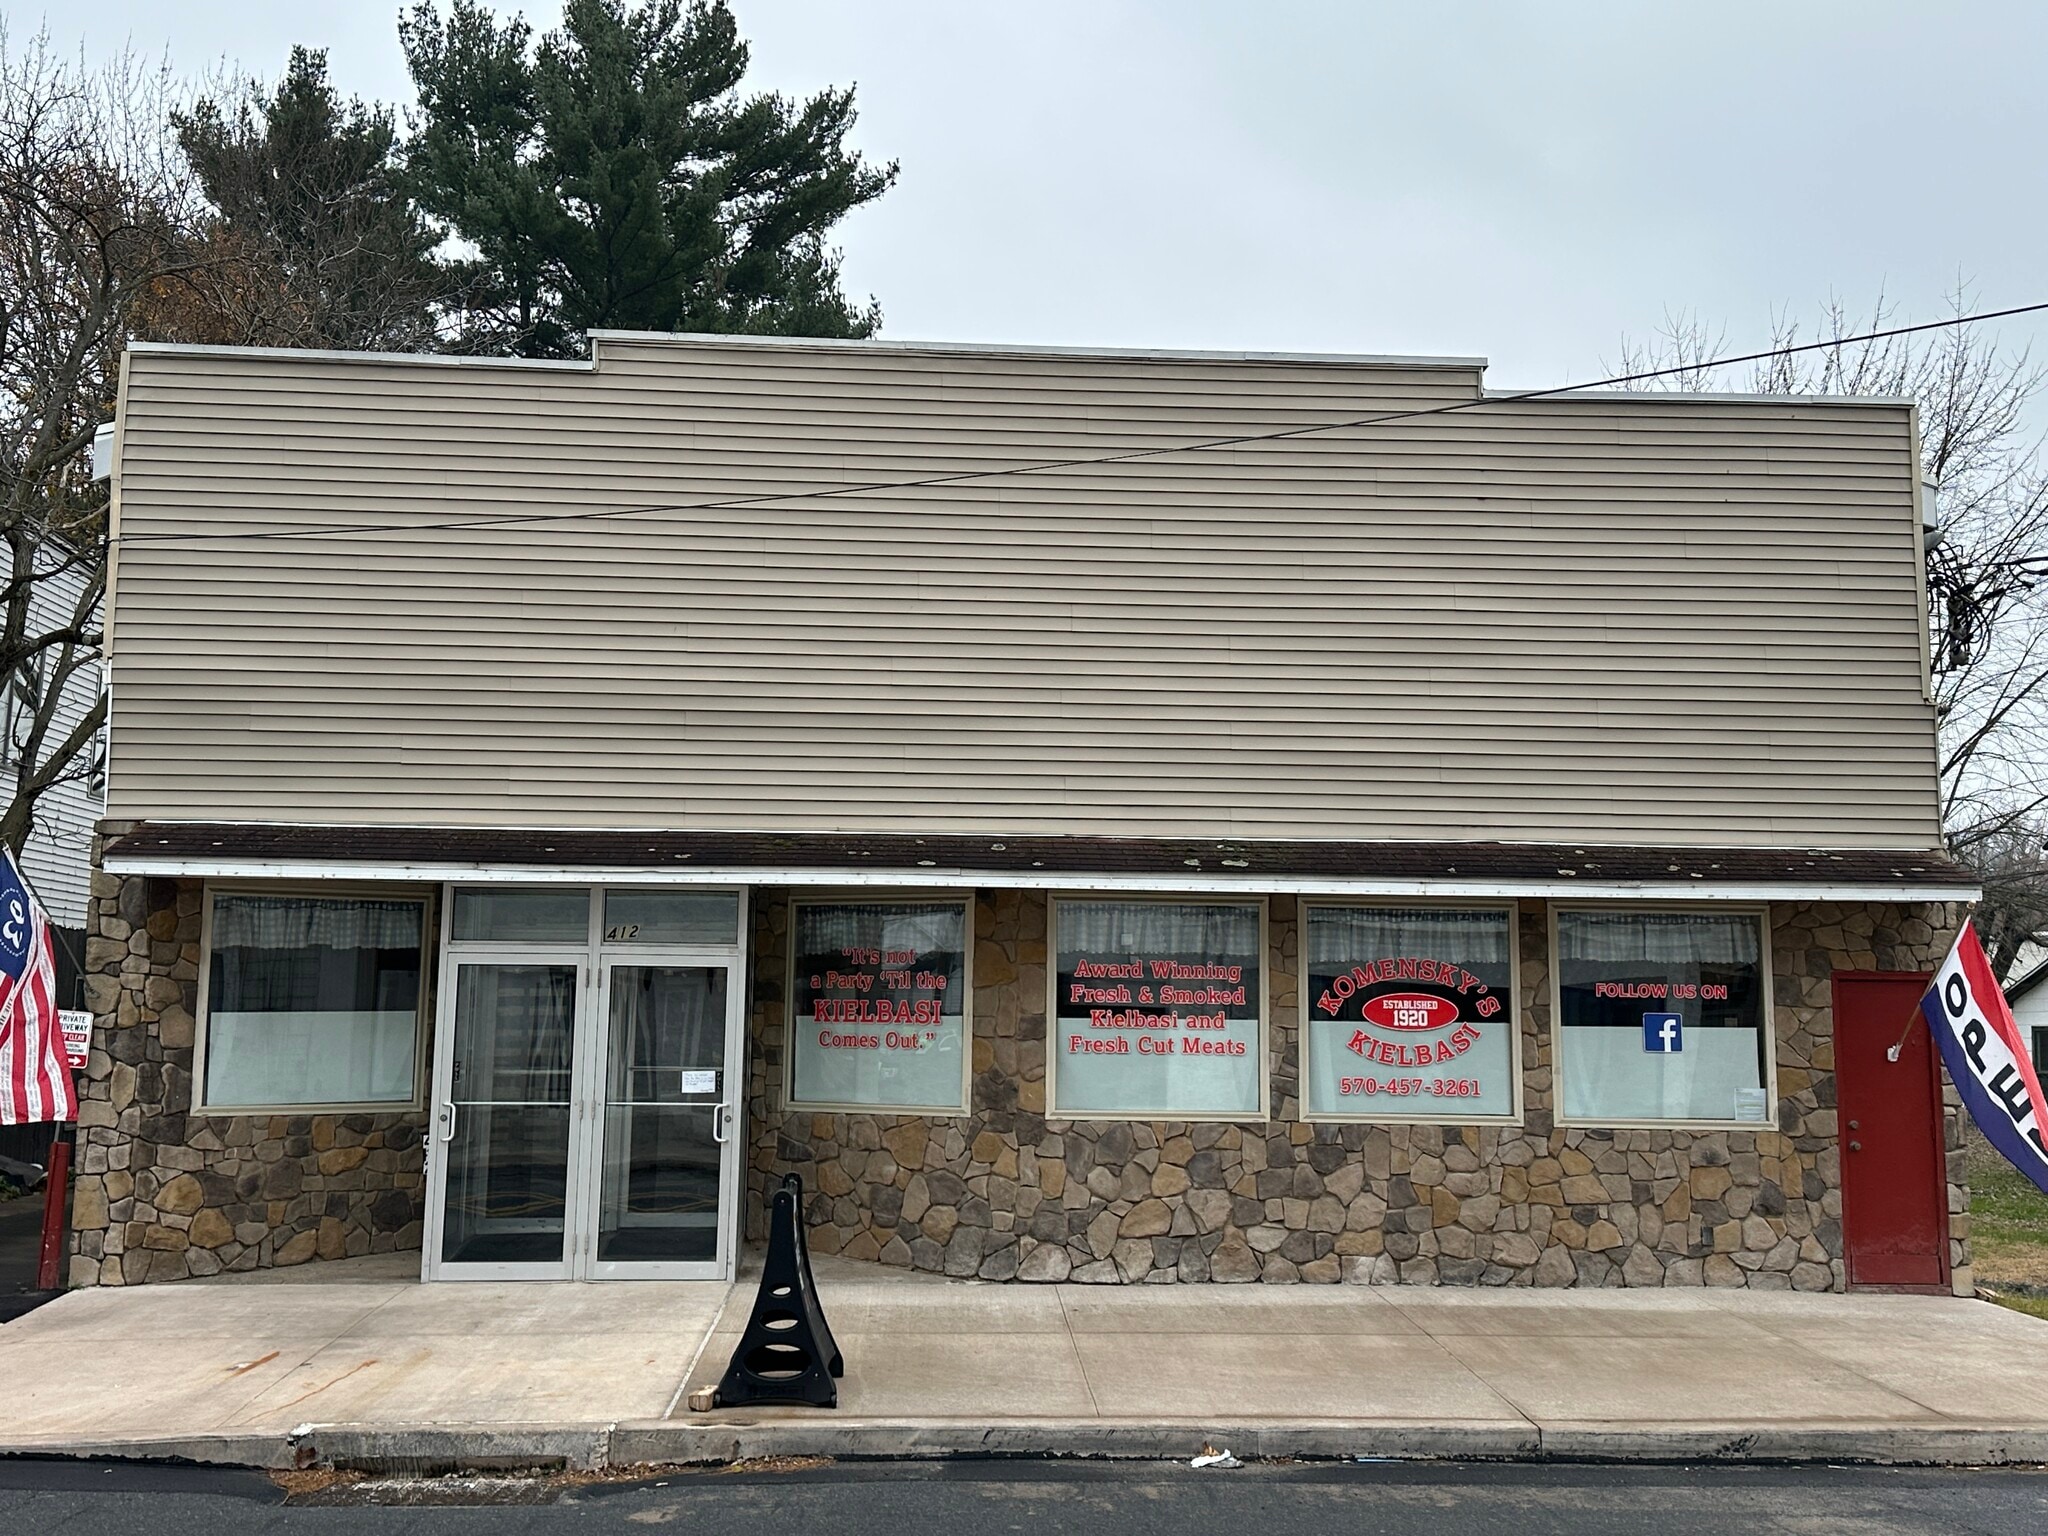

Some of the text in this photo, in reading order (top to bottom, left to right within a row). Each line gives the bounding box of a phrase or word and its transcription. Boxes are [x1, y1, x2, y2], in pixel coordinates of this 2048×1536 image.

[607, 925, 639, 940] 412
[885, 949, 916, 965] not
[1074, 959, 1242, 983] Award Winning
[810, 976, 822, 989] a
[826, 971, 874, 993] Party
[916, 971, 947, 989] the
[1317, 957, 1501, 1018] KOMENSKY'S
[1595, 982, 1727, 1000] FOLLOW US ON
[1070, 984, 1246, 1005] Fresh & Smoked
[1382, 999, 1438, 1010] ESTABLISHED
[813, 999, 942, 1025] KIELBASI
[1090, 1010, 1226, 1030] Kielbasi and
[1393, 1010, 1429, 1027] 1920
[818, 1031, 879, 1048] Comes
[1068, 1035, 1246, 1056] Fresh Cut Meats
[1346, 1022, 1482, 1067] KIELBASI
[1340, 1077, 1481, 1096] 570-457-3261
